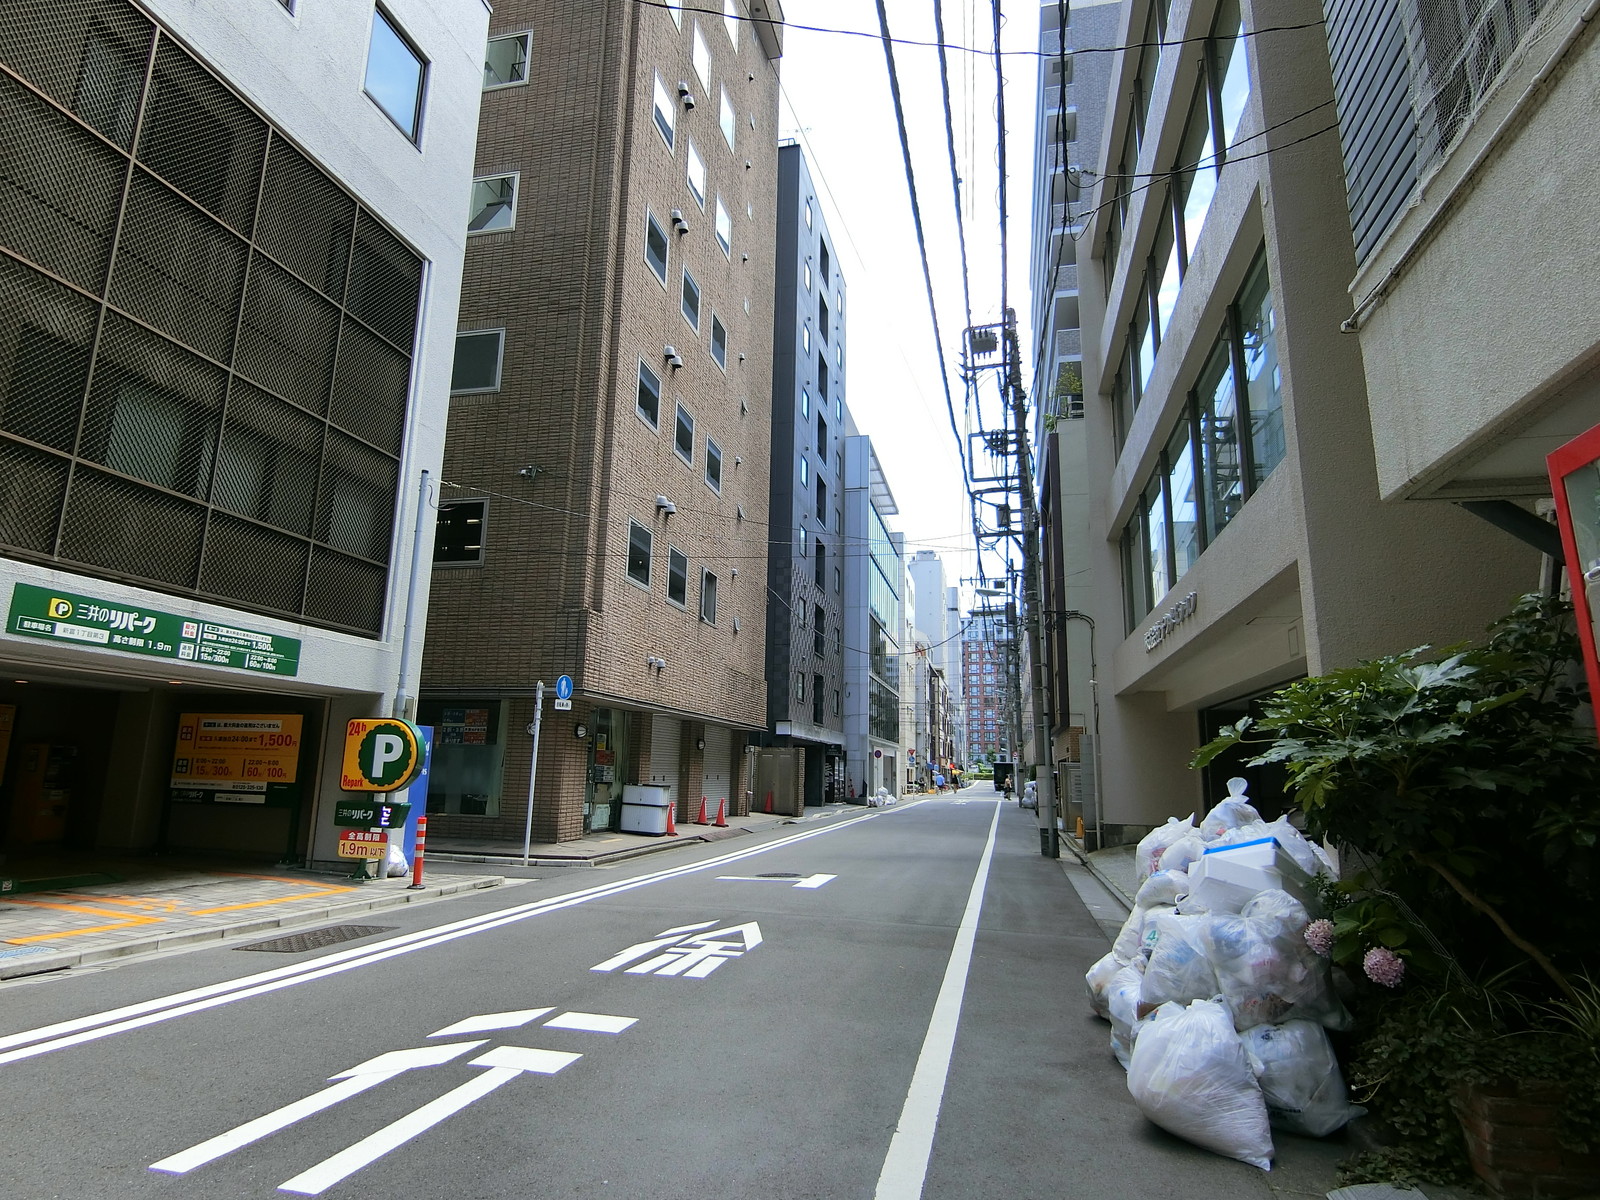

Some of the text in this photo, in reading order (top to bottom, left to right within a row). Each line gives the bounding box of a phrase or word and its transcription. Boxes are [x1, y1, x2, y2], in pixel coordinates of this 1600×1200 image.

[58, 603, 69, 615] P
[76, 603, 157, 634] 三井のリパーク
[113, 634, 172, 652] 高さ制限 1.9m
[371, 733, 404, 778] P
[342, 774, 364, 788] Repark
[338, 809, 374, 820] 三井のリパーク
[347, 831, 381, 842] 全高制限
[340, 842, 385, 857] 1.9m 以下
